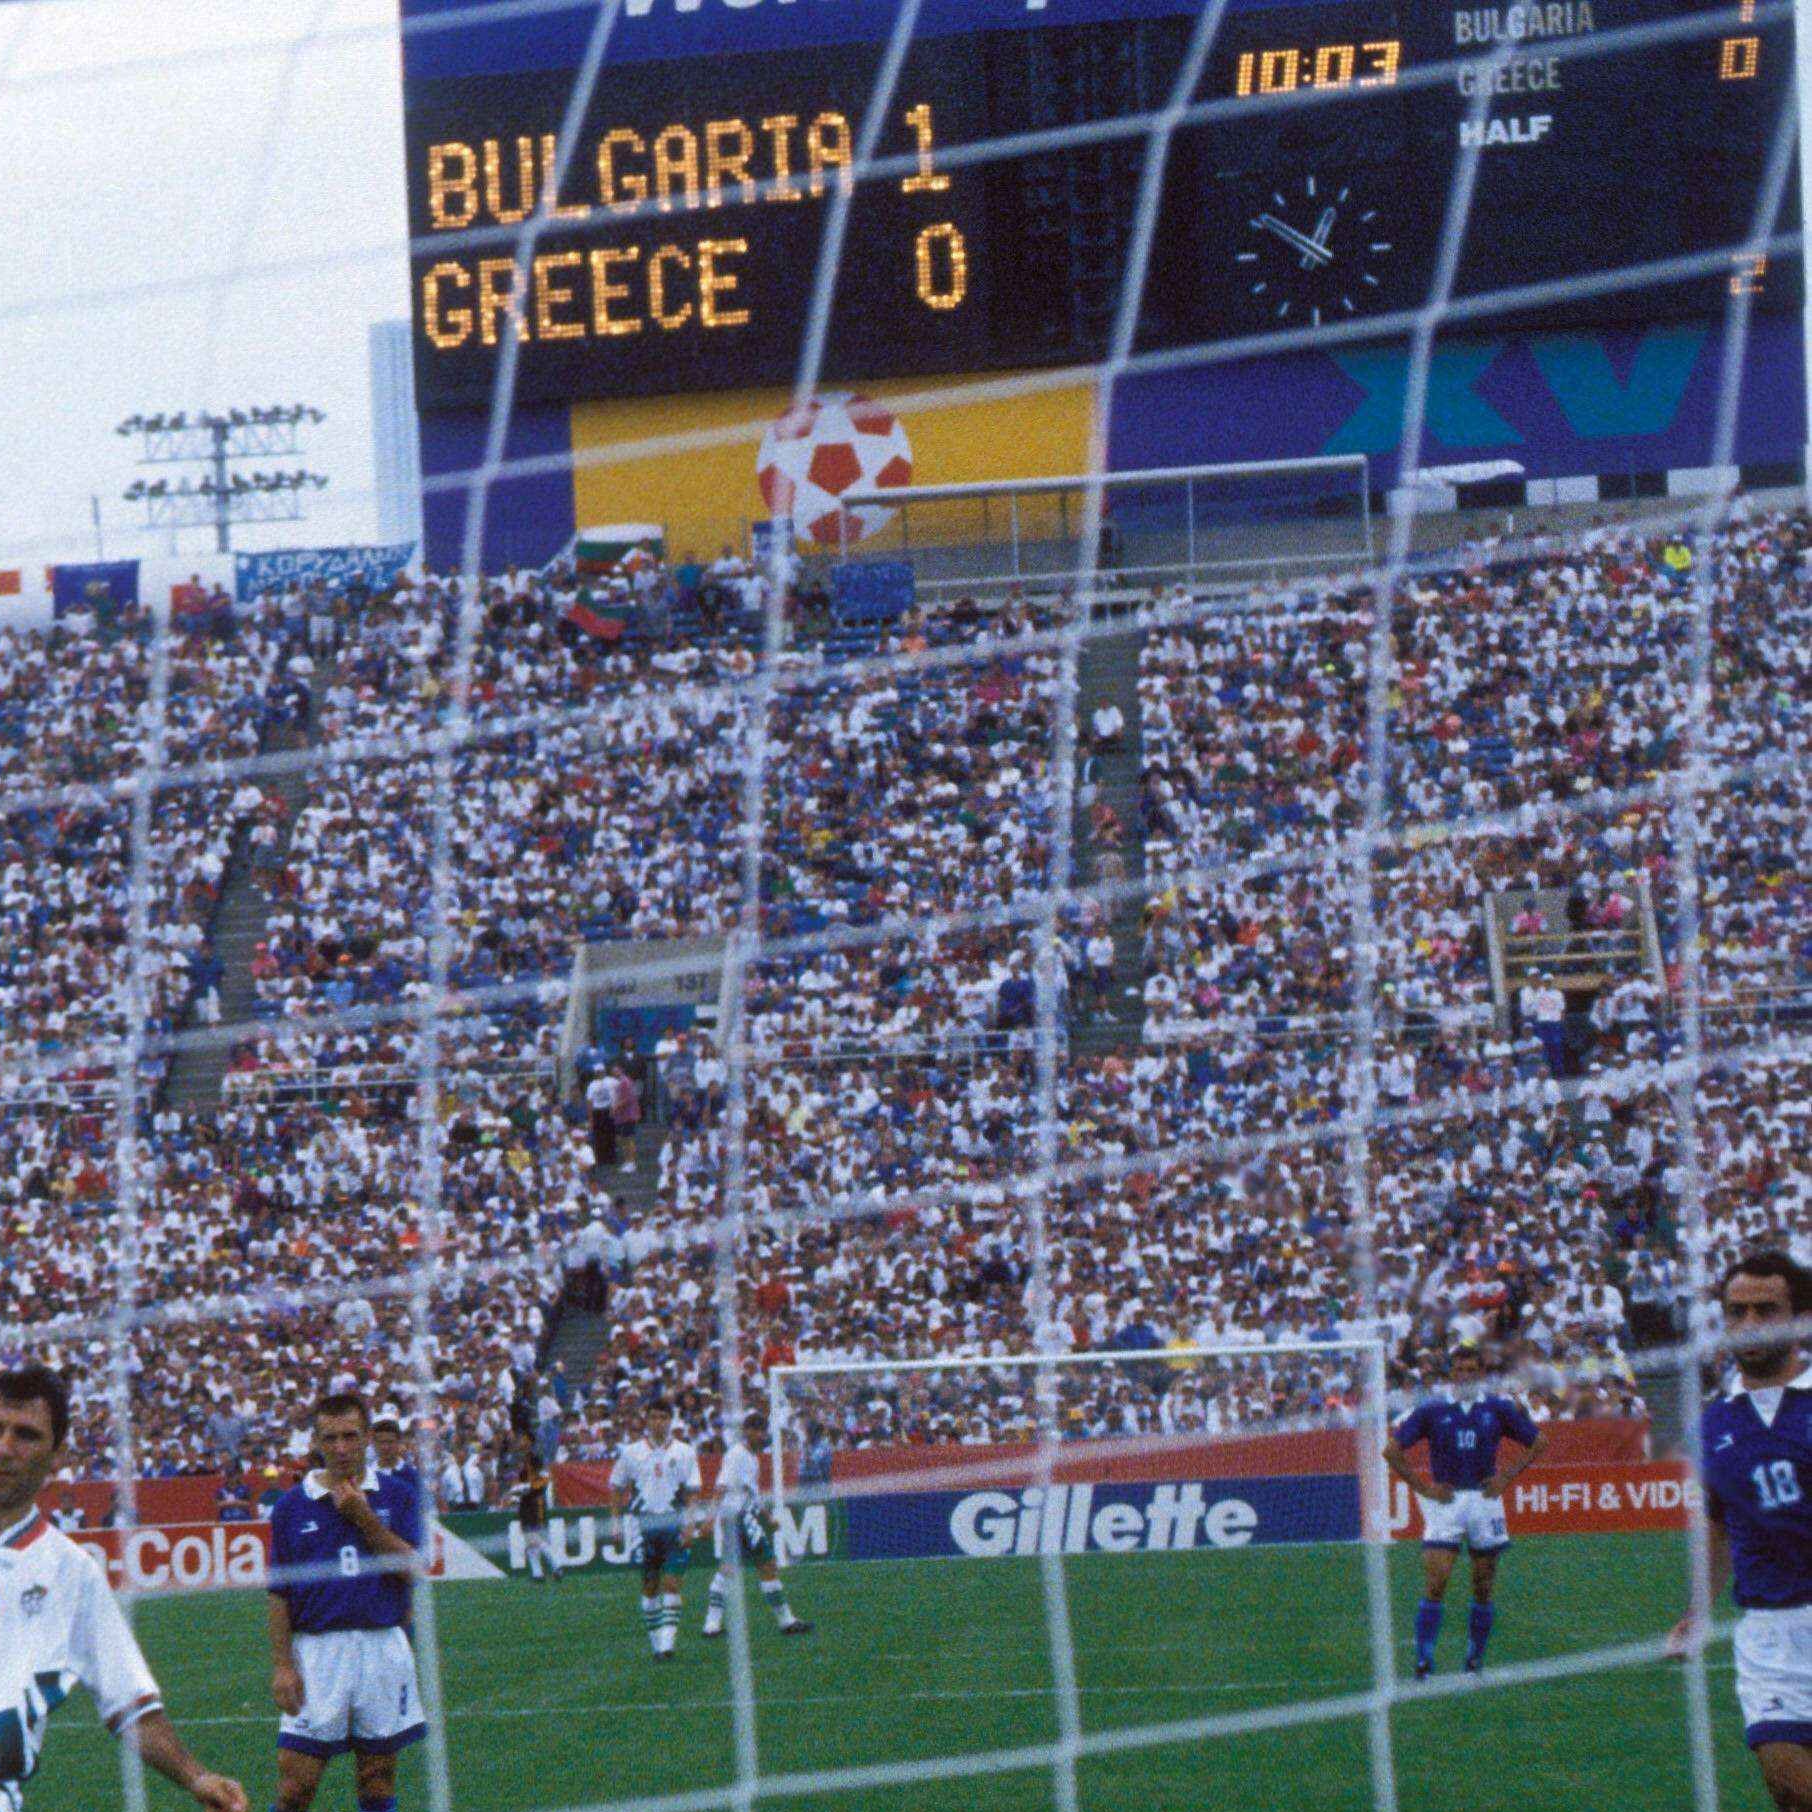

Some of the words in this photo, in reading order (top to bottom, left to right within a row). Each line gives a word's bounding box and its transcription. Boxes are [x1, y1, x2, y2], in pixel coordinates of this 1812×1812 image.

[1455, 4, 1595, 44] BULGARIA
[1236, 39, 1401, 97] 10:03
[1459, 115, 1553, 149] HALF
[427, 111, 856, 229] BULGARIA
[901, 104, 952, 193] 1
[422, 238, 751, 350] GREECE
[915, 222, 968, 311] 0
[950, 1483, 1259, 1557] Gillette
[1514, 1484, 1591, 1514] HI-FI
[1598, 1483, 1622, 1511] &
[1625, 1479, 1701, 1509] VIDE
[339, 1544, 361, 1577] 8
